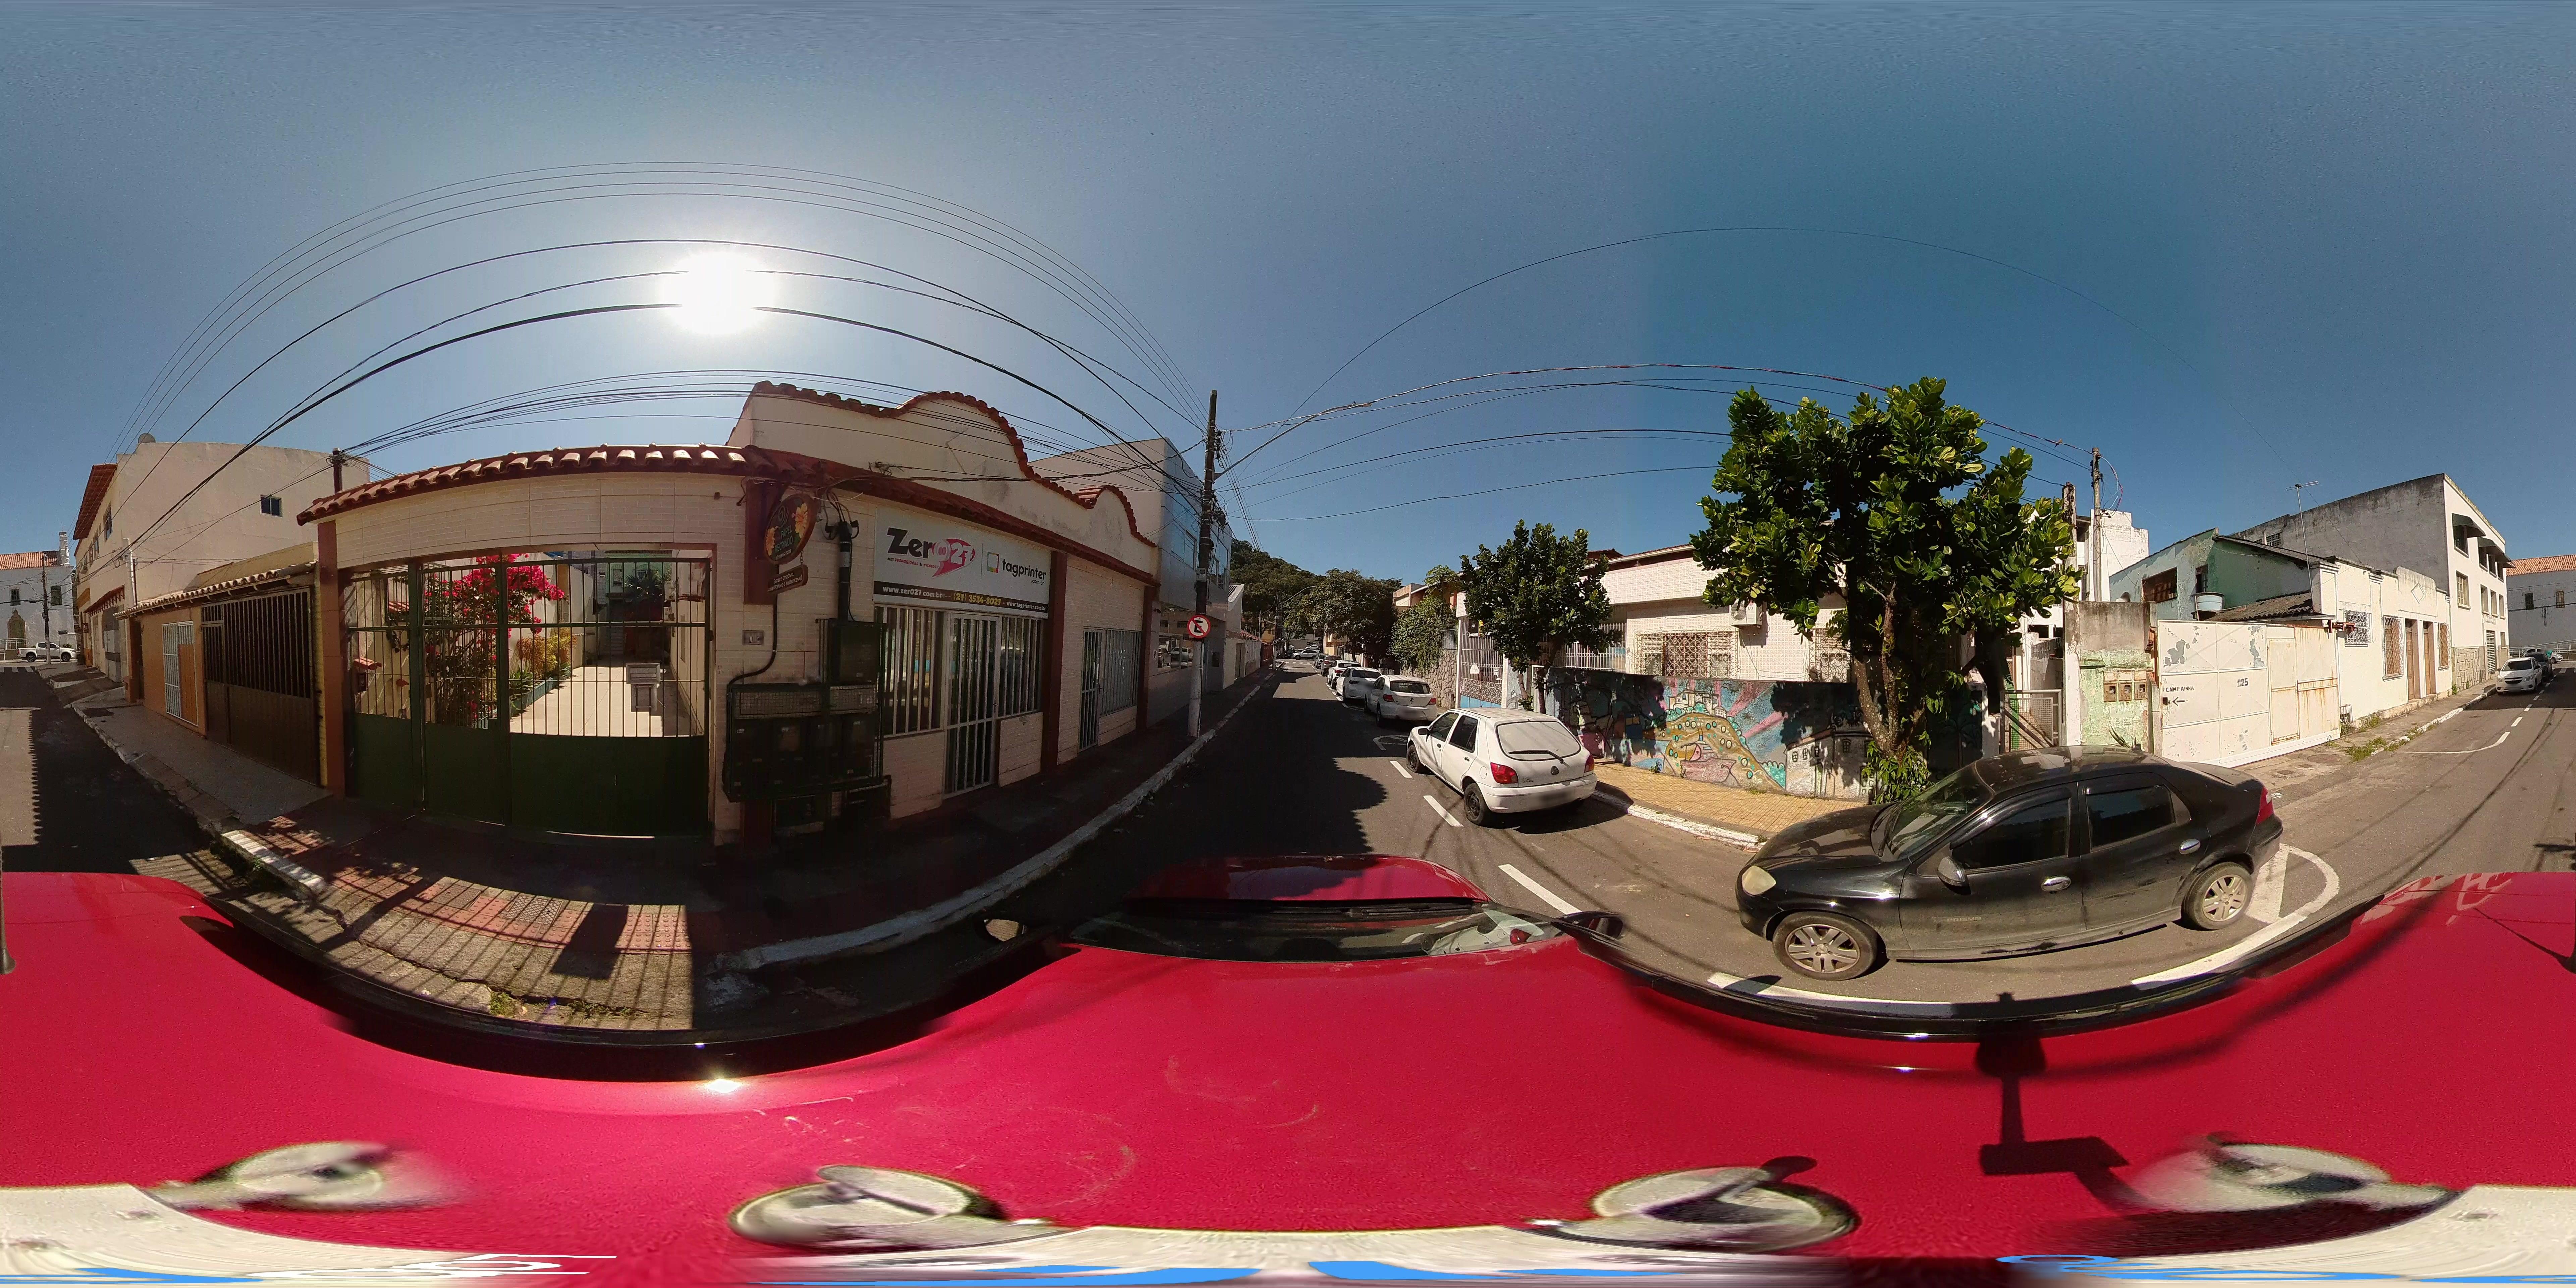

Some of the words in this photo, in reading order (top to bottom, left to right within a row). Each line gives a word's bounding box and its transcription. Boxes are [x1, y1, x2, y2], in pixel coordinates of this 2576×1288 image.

[781, 525, 792, 539] PAPEL
[775, 536, 793, 553] RECRIADO
[1002, 559, 1046, 580] tagprinter
[953, 592, 966, 602] (27)
[968, 594, 1001, 605] 3534-8027
[1006, 601, 1046, 611] www.tagprinter.com.br
